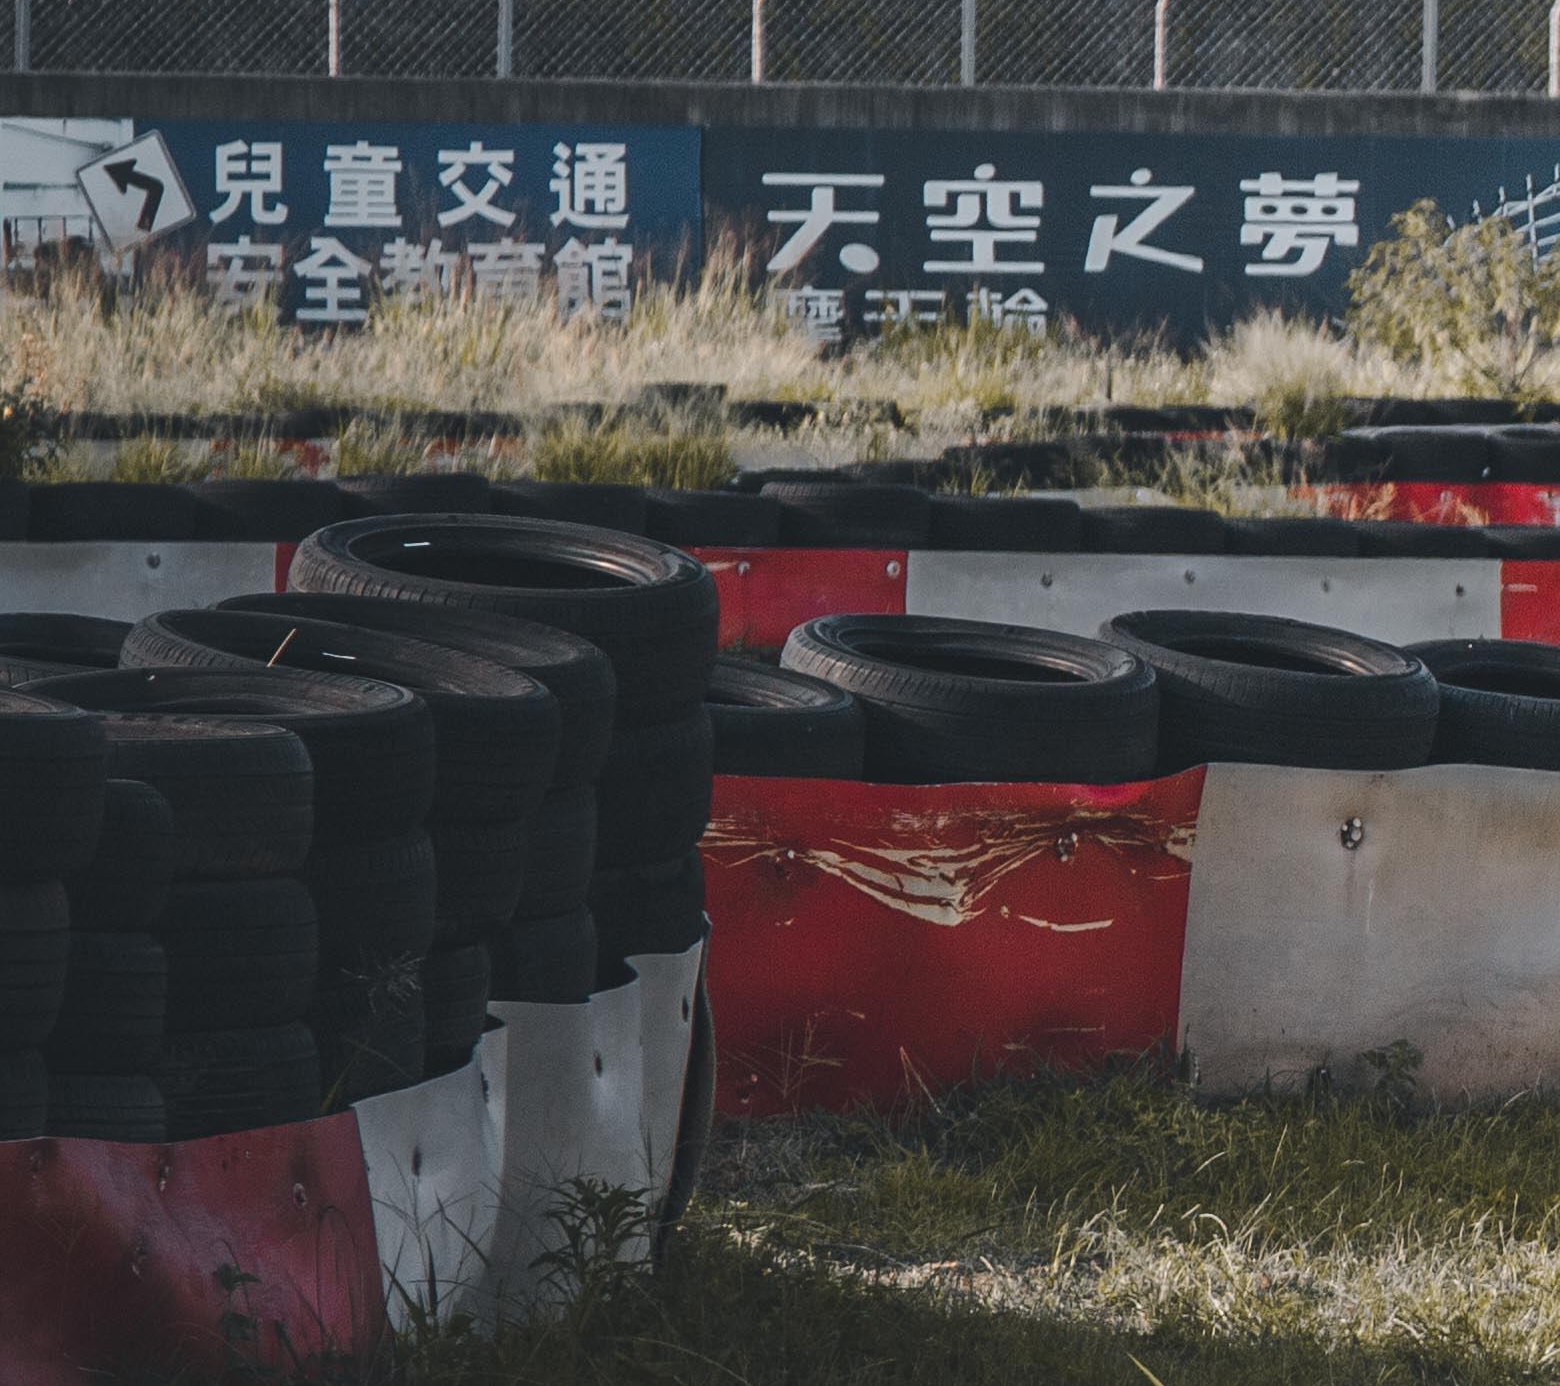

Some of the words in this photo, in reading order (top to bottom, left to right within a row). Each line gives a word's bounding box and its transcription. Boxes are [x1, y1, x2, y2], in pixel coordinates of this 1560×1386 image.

[208, 139, 629, 229] 兒童交通
[761, 162, 1360, 277] 天空之夢
